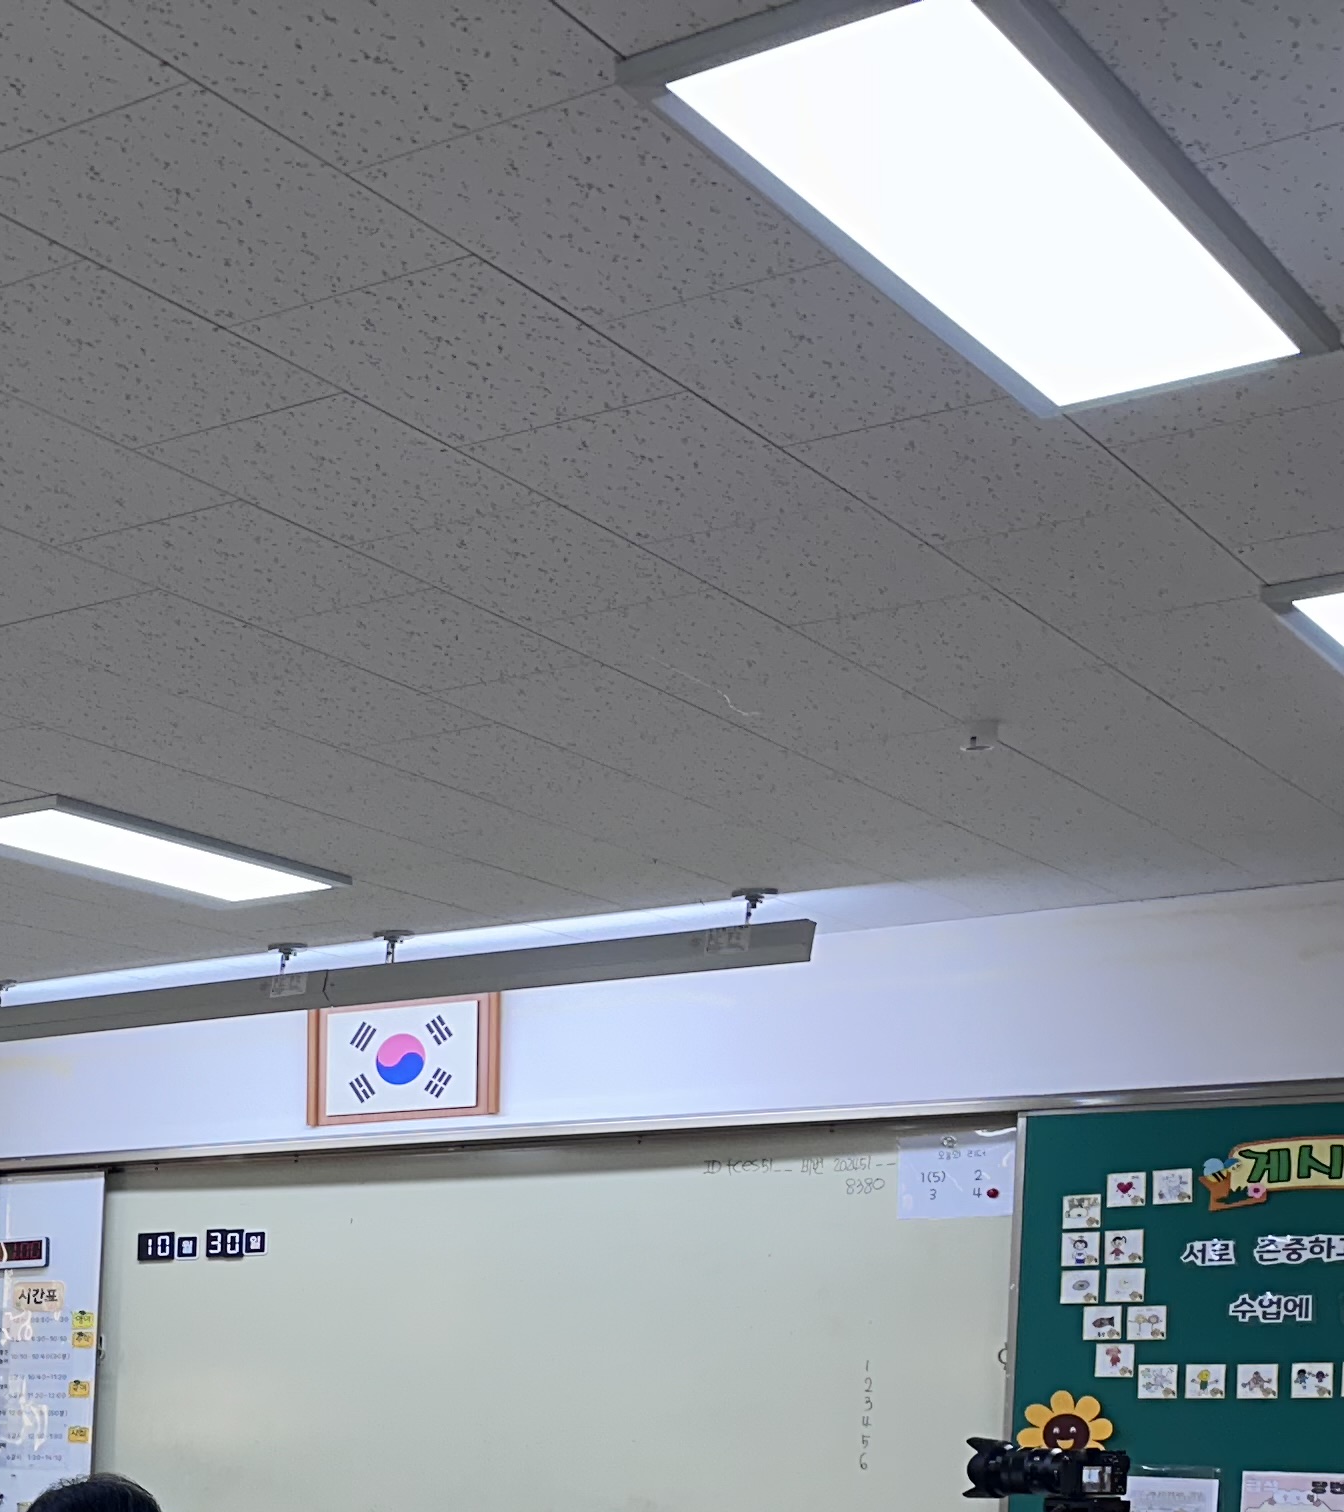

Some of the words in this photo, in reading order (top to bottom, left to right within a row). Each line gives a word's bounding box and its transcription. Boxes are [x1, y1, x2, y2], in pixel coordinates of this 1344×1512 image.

[703, 1159, 722, 1175] ID
[921, 1170, 946, 1183] 1(5)
[974, 1169, 982, 1181] 2
[929, 1188, 937, 1200] 3
[972, 1187, 982, 1198] 4
[1183, 1242, 1234, 1265] 서로
[18, 1287, 59, 1305] 시간표
[1231, 1297, 1310, 1321] 수업에
[864, 1377, 873, 1393] 2
[863, 1396, 873, 1412] 3
[862, 1415, 872, 1428] 4
[861, 1434, 871, 1449] 5
[859, 1452, 868, 1470] 6
